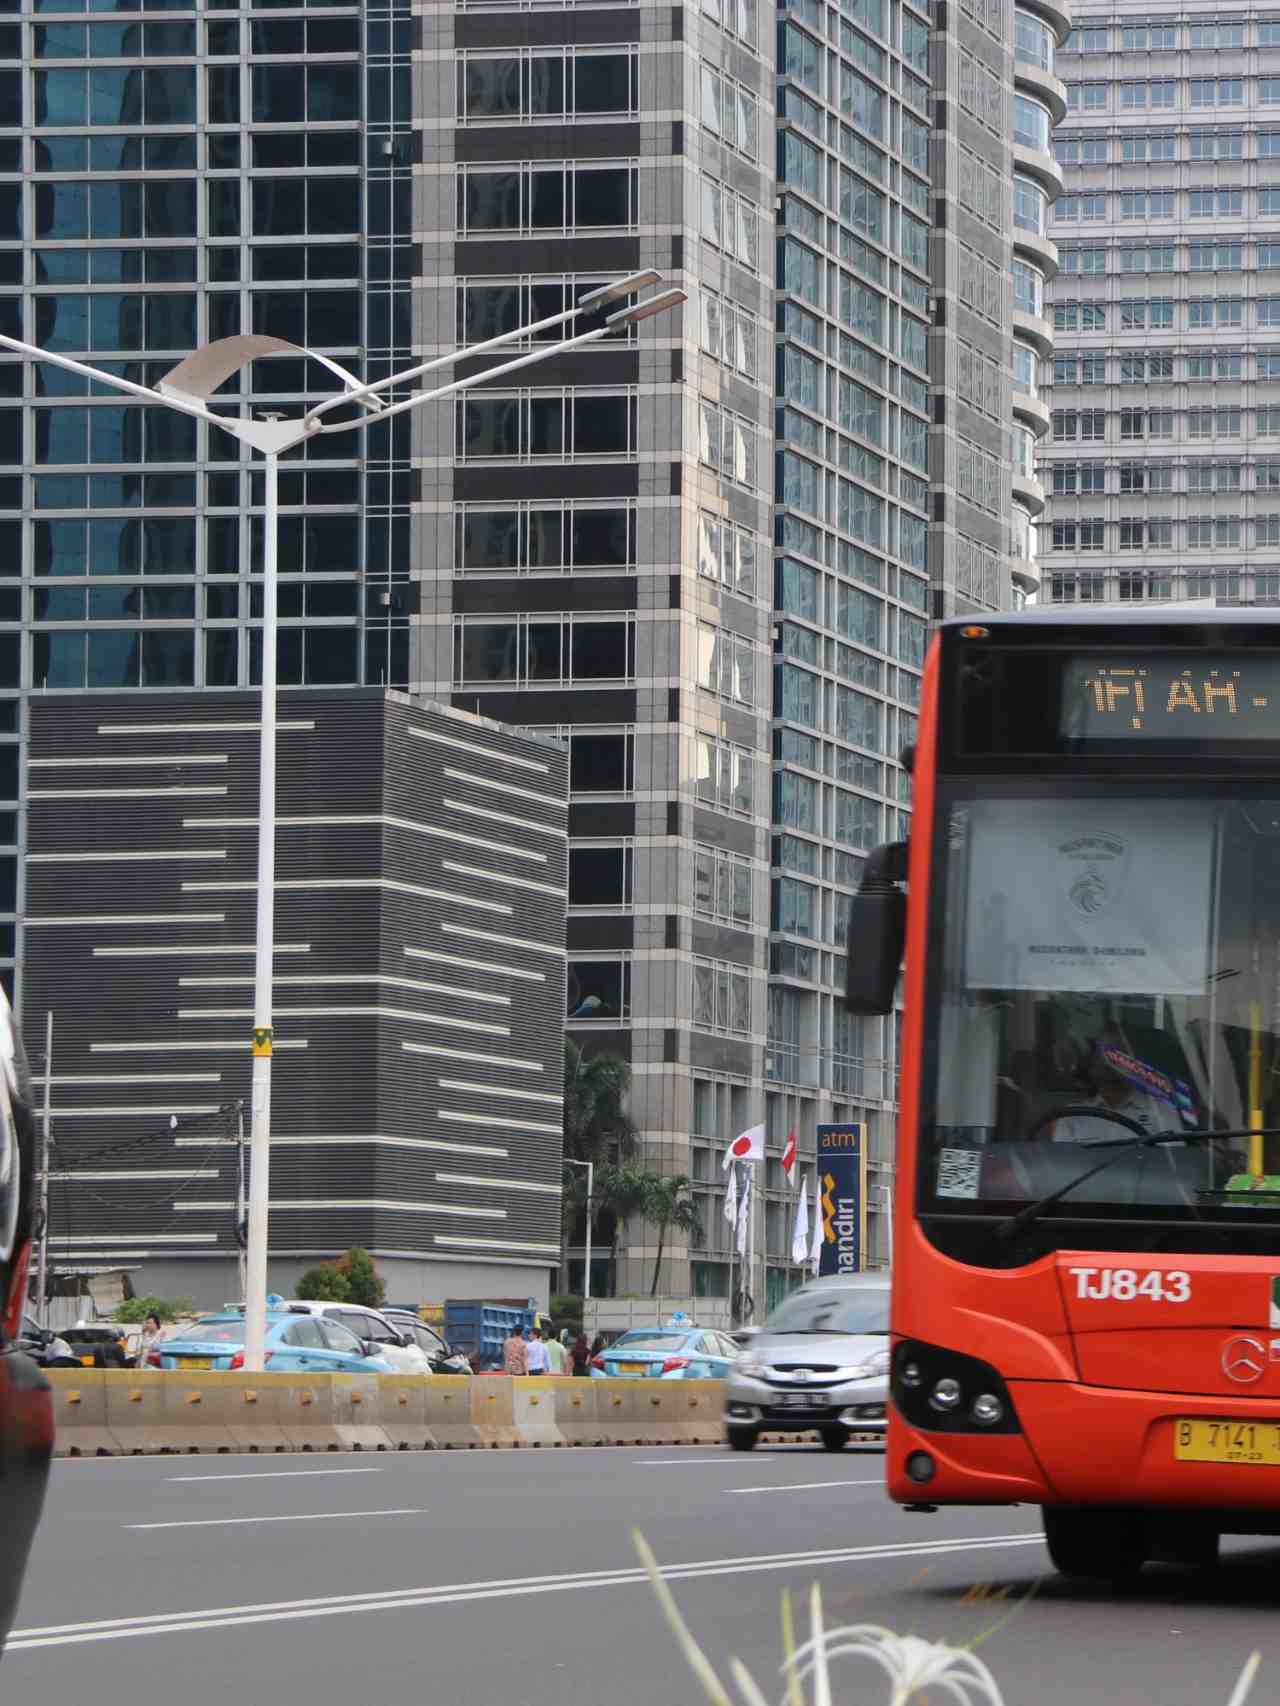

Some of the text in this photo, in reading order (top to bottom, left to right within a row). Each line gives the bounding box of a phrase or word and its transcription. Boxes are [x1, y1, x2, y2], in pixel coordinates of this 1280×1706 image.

[822, 1133, 855, 1148] atm
[1069, 1268, 1192, 1302] TJ843
[1180, 1423, 1192, 1446] B
[1208, 1424, 1257, 1449] 7141
